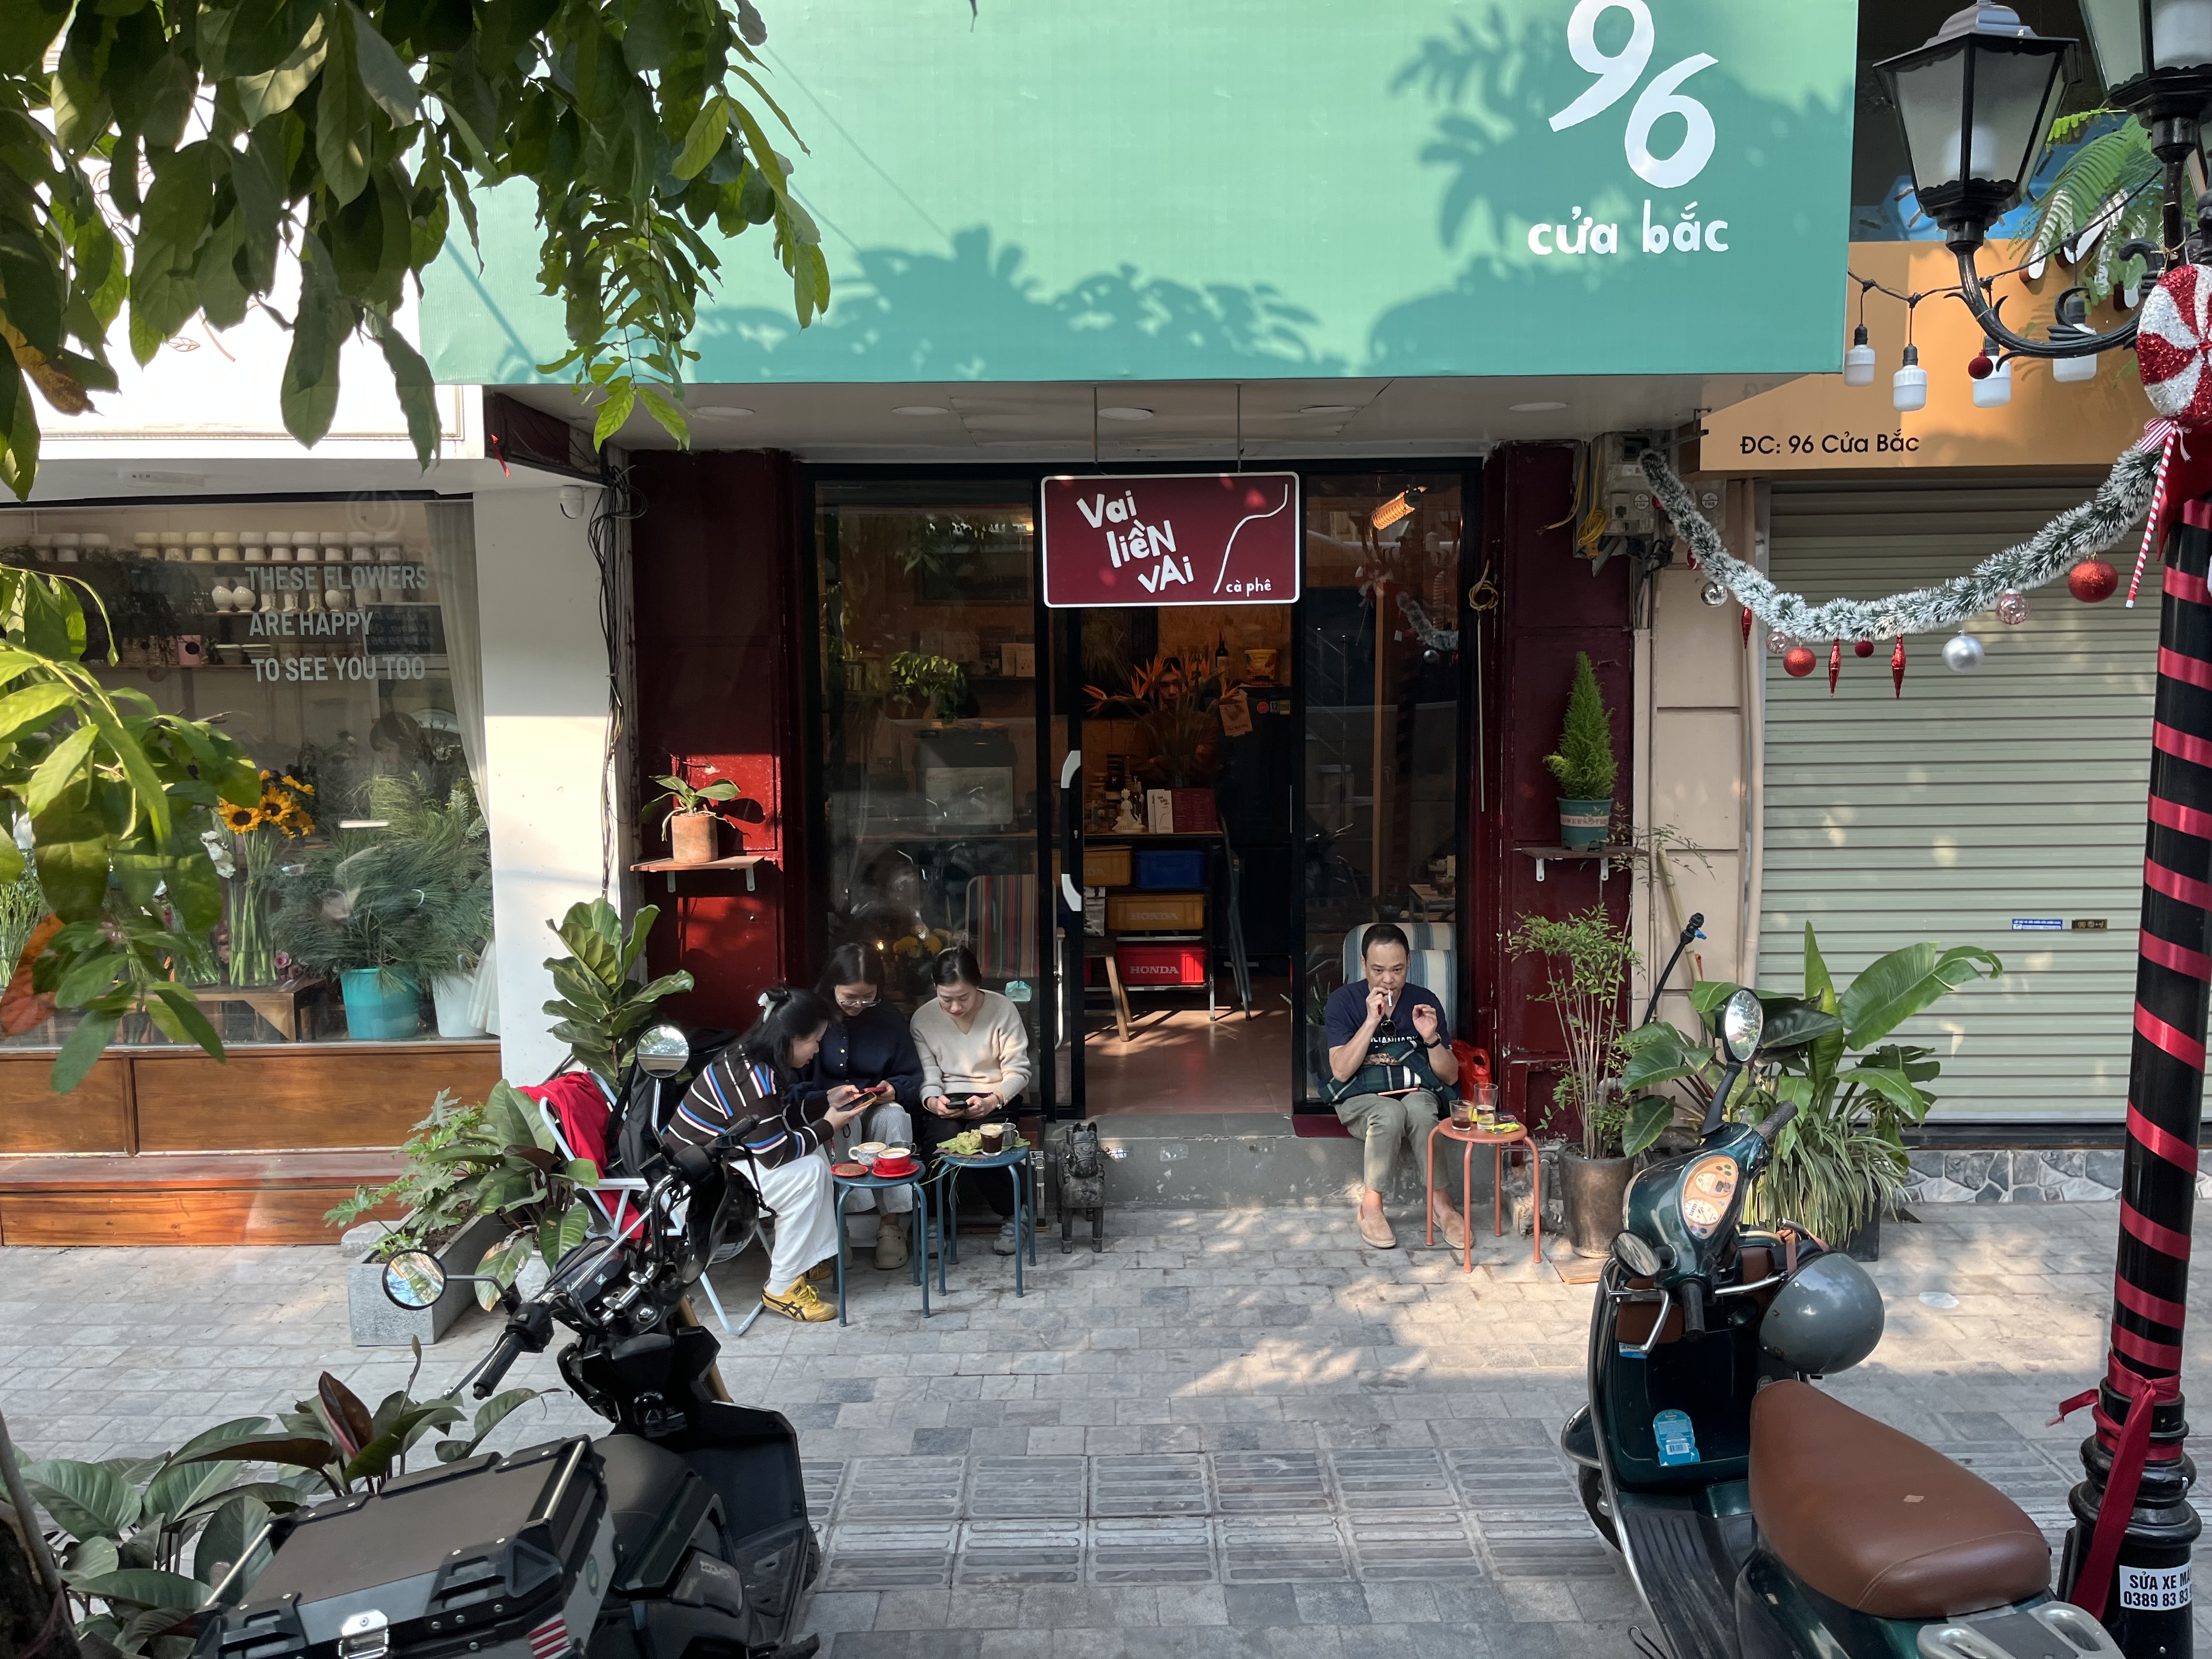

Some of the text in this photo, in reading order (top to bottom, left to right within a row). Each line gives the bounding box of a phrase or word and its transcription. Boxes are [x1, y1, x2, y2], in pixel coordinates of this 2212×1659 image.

[1549, 0, 1718, 188] 96
[1528, 199, 1729, 255] cửa bắc
[1740, 428, 1920, 454] ĐC: 96 Cửa Bắc
[1076, 490, 1137, 528] Vai
[245, 566, 431, 590] THESE FLOWERS
[1226, 577, 1272, 597] cà phê
[250, 612, 295, 636] ARE
[300, 612, 373, 636] HAPPY
[251, 656, 425, 682] TO SEE YOU TOO
[2130, 1571, 2158, 1590] SỬA
[2163, 1575, 2176, 1589] XE
[2124, 1591, 2158, 1607] 0389
[2163, 1593, 2176, 1606] 83
[2180, 1588, 2188, 1604] 83
